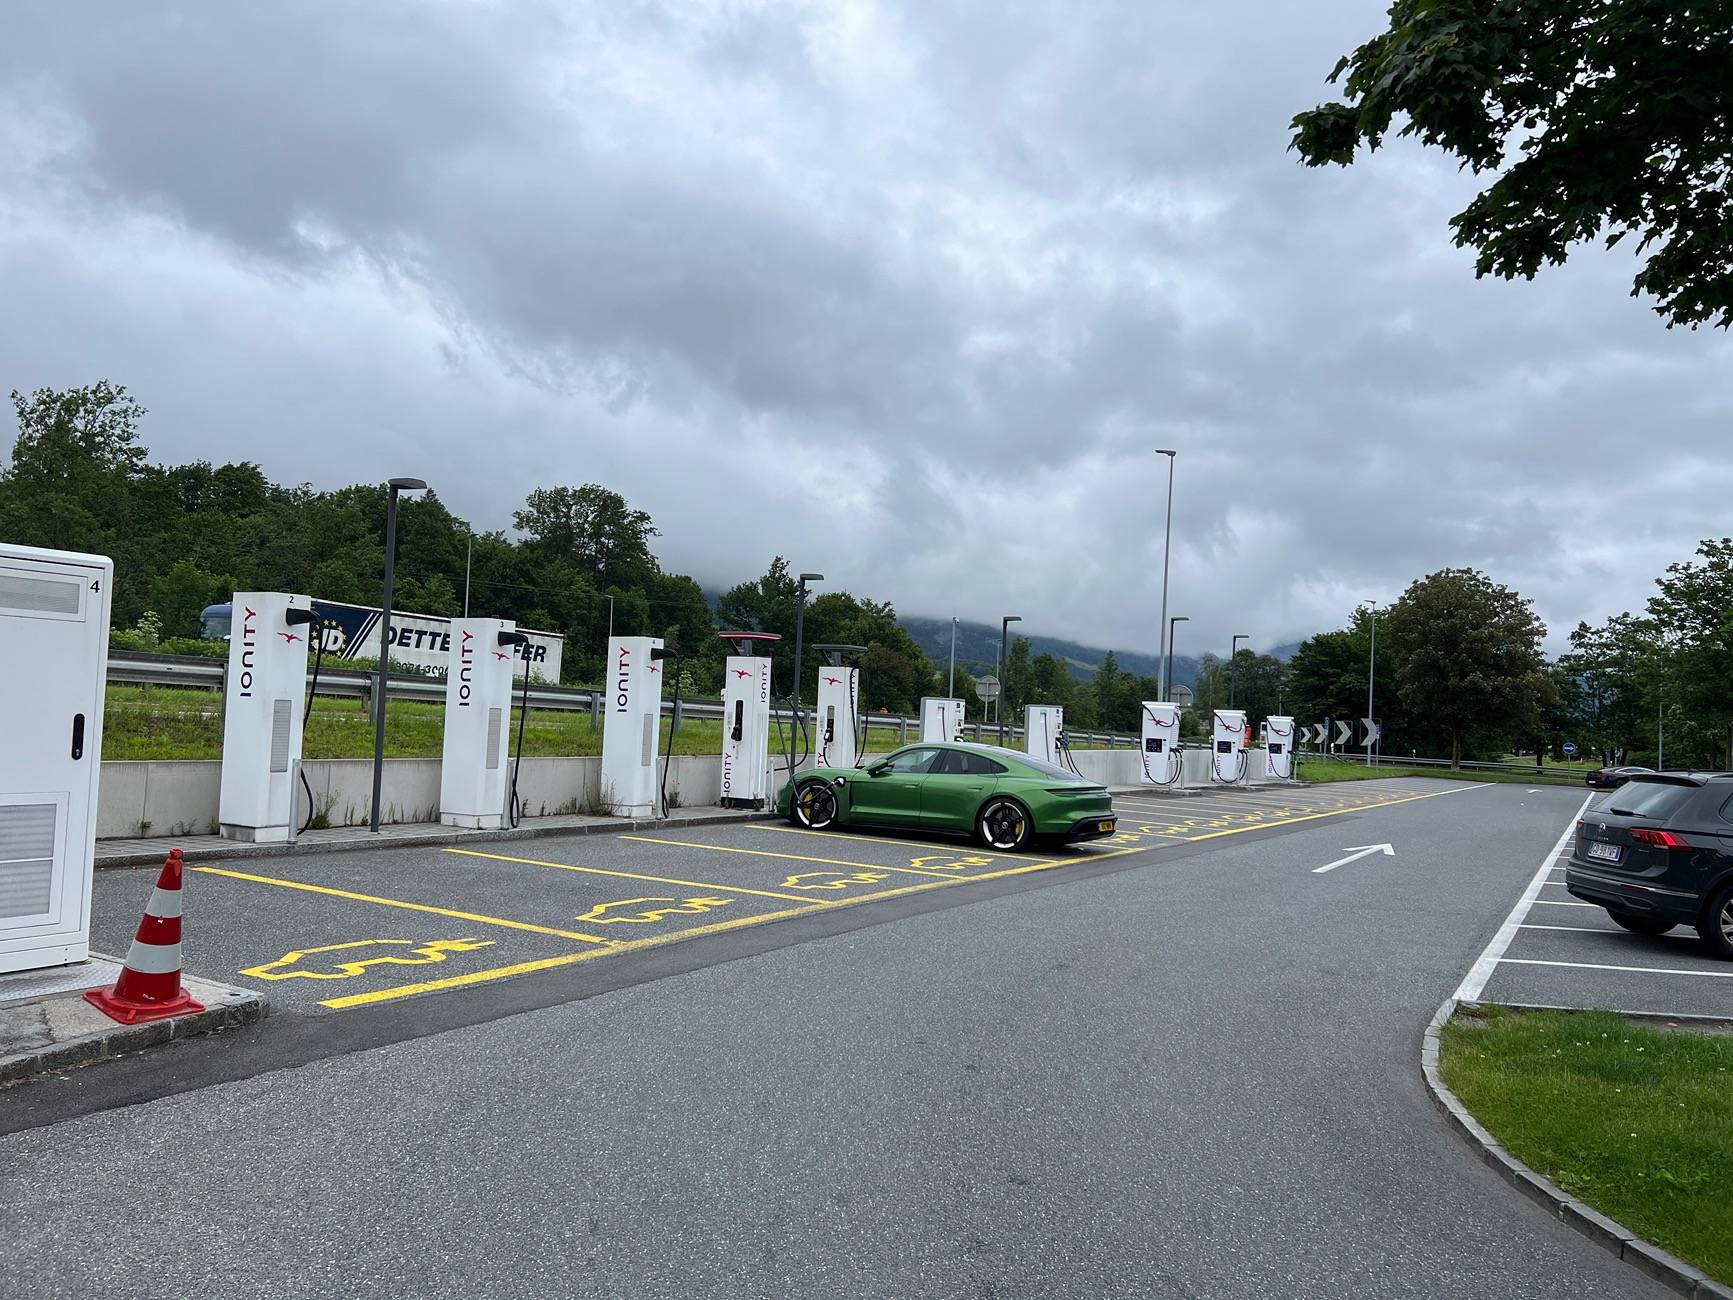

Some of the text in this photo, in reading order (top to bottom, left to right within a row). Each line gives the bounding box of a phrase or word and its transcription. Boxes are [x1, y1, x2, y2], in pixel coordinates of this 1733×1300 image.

[90, 580, 100, 593] 4
[289, 595, 294, 604] 2
[240, 606, 257, 697] IONITY
[459, 630, 474, 706] IONITY
[617, 647, 630, 712] IONITY
[760, 663, 768, 703] IONITY
[723, 752, 733, 793] IONITY
